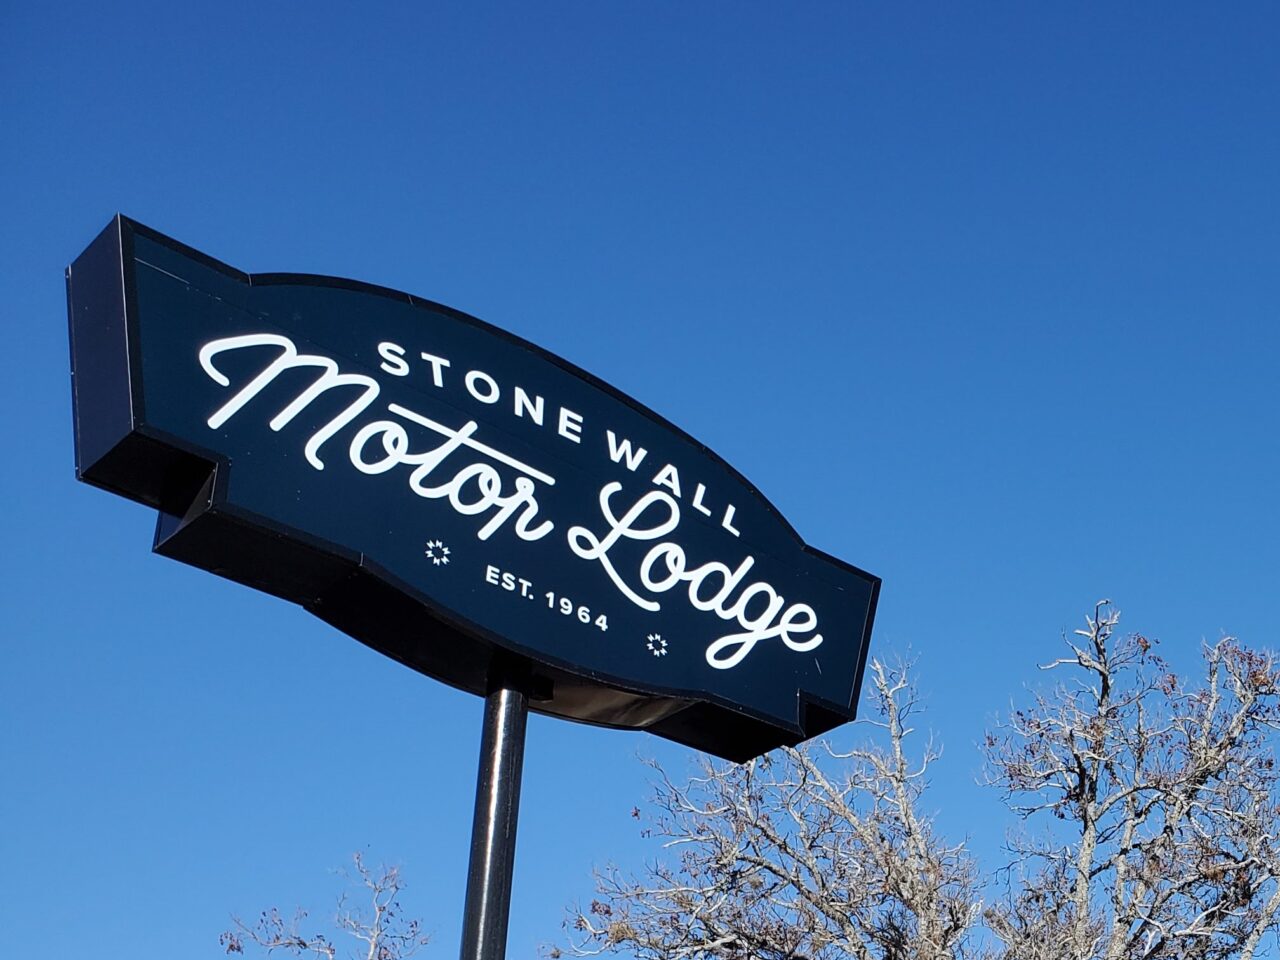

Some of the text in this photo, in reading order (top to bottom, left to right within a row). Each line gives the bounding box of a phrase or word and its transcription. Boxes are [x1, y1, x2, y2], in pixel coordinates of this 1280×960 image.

[198, 333, 824, 670] Motor Lodge
[377, 341, 742, 538] STONE WALL
[485, 564, 610, 632] EST. 1964
